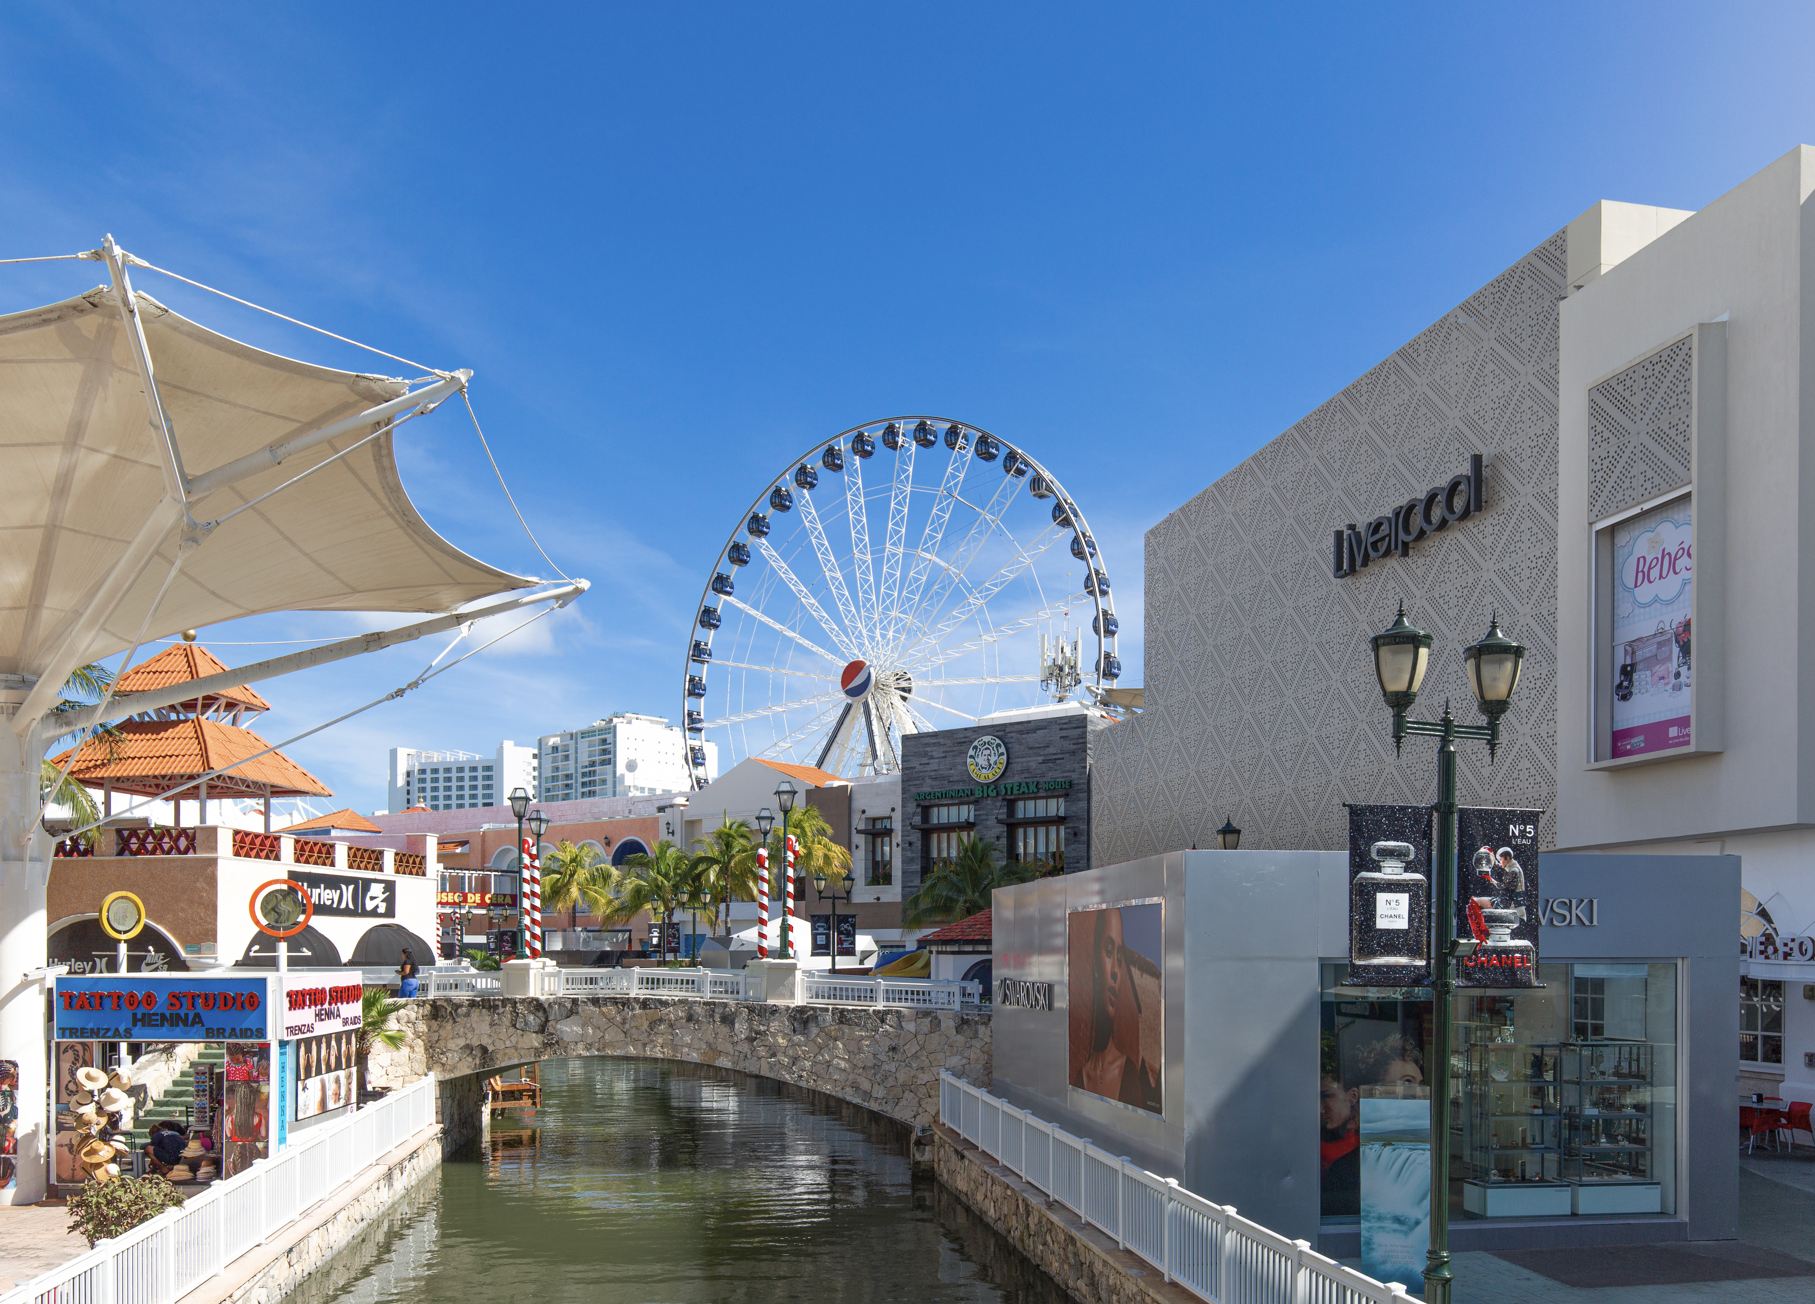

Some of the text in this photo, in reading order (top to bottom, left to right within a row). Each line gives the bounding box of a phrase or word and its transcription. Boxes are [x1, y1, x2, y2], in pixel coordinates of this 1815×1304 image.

[1333, 454, 1483, 578] Liverpool
[914, 780, 1072, 801] ARGENTINIAN BIG STEAK HOUSE
[467, 893, 481, 904] DE
[484, 893, 512, 904] CERA
[49, 958, 92, 973] Hrley
[1462, 954, 1532, 968] CHANEL
[59, 990, 261, 1011] TATTOO STUDIO
[286, 984, 363, 1011] TATTOO STUDIO
[1005, 980, 1049, 1011] SWAROVSKI
[131, 1012, 205, 1028] HENNA
[314, 1006, 341, 1023] HENNA
[59, 1027, 264, 1039] TRENZAS BRAIDS
[285, 1015, 361, 1037] TRENZAS BRAIDS
